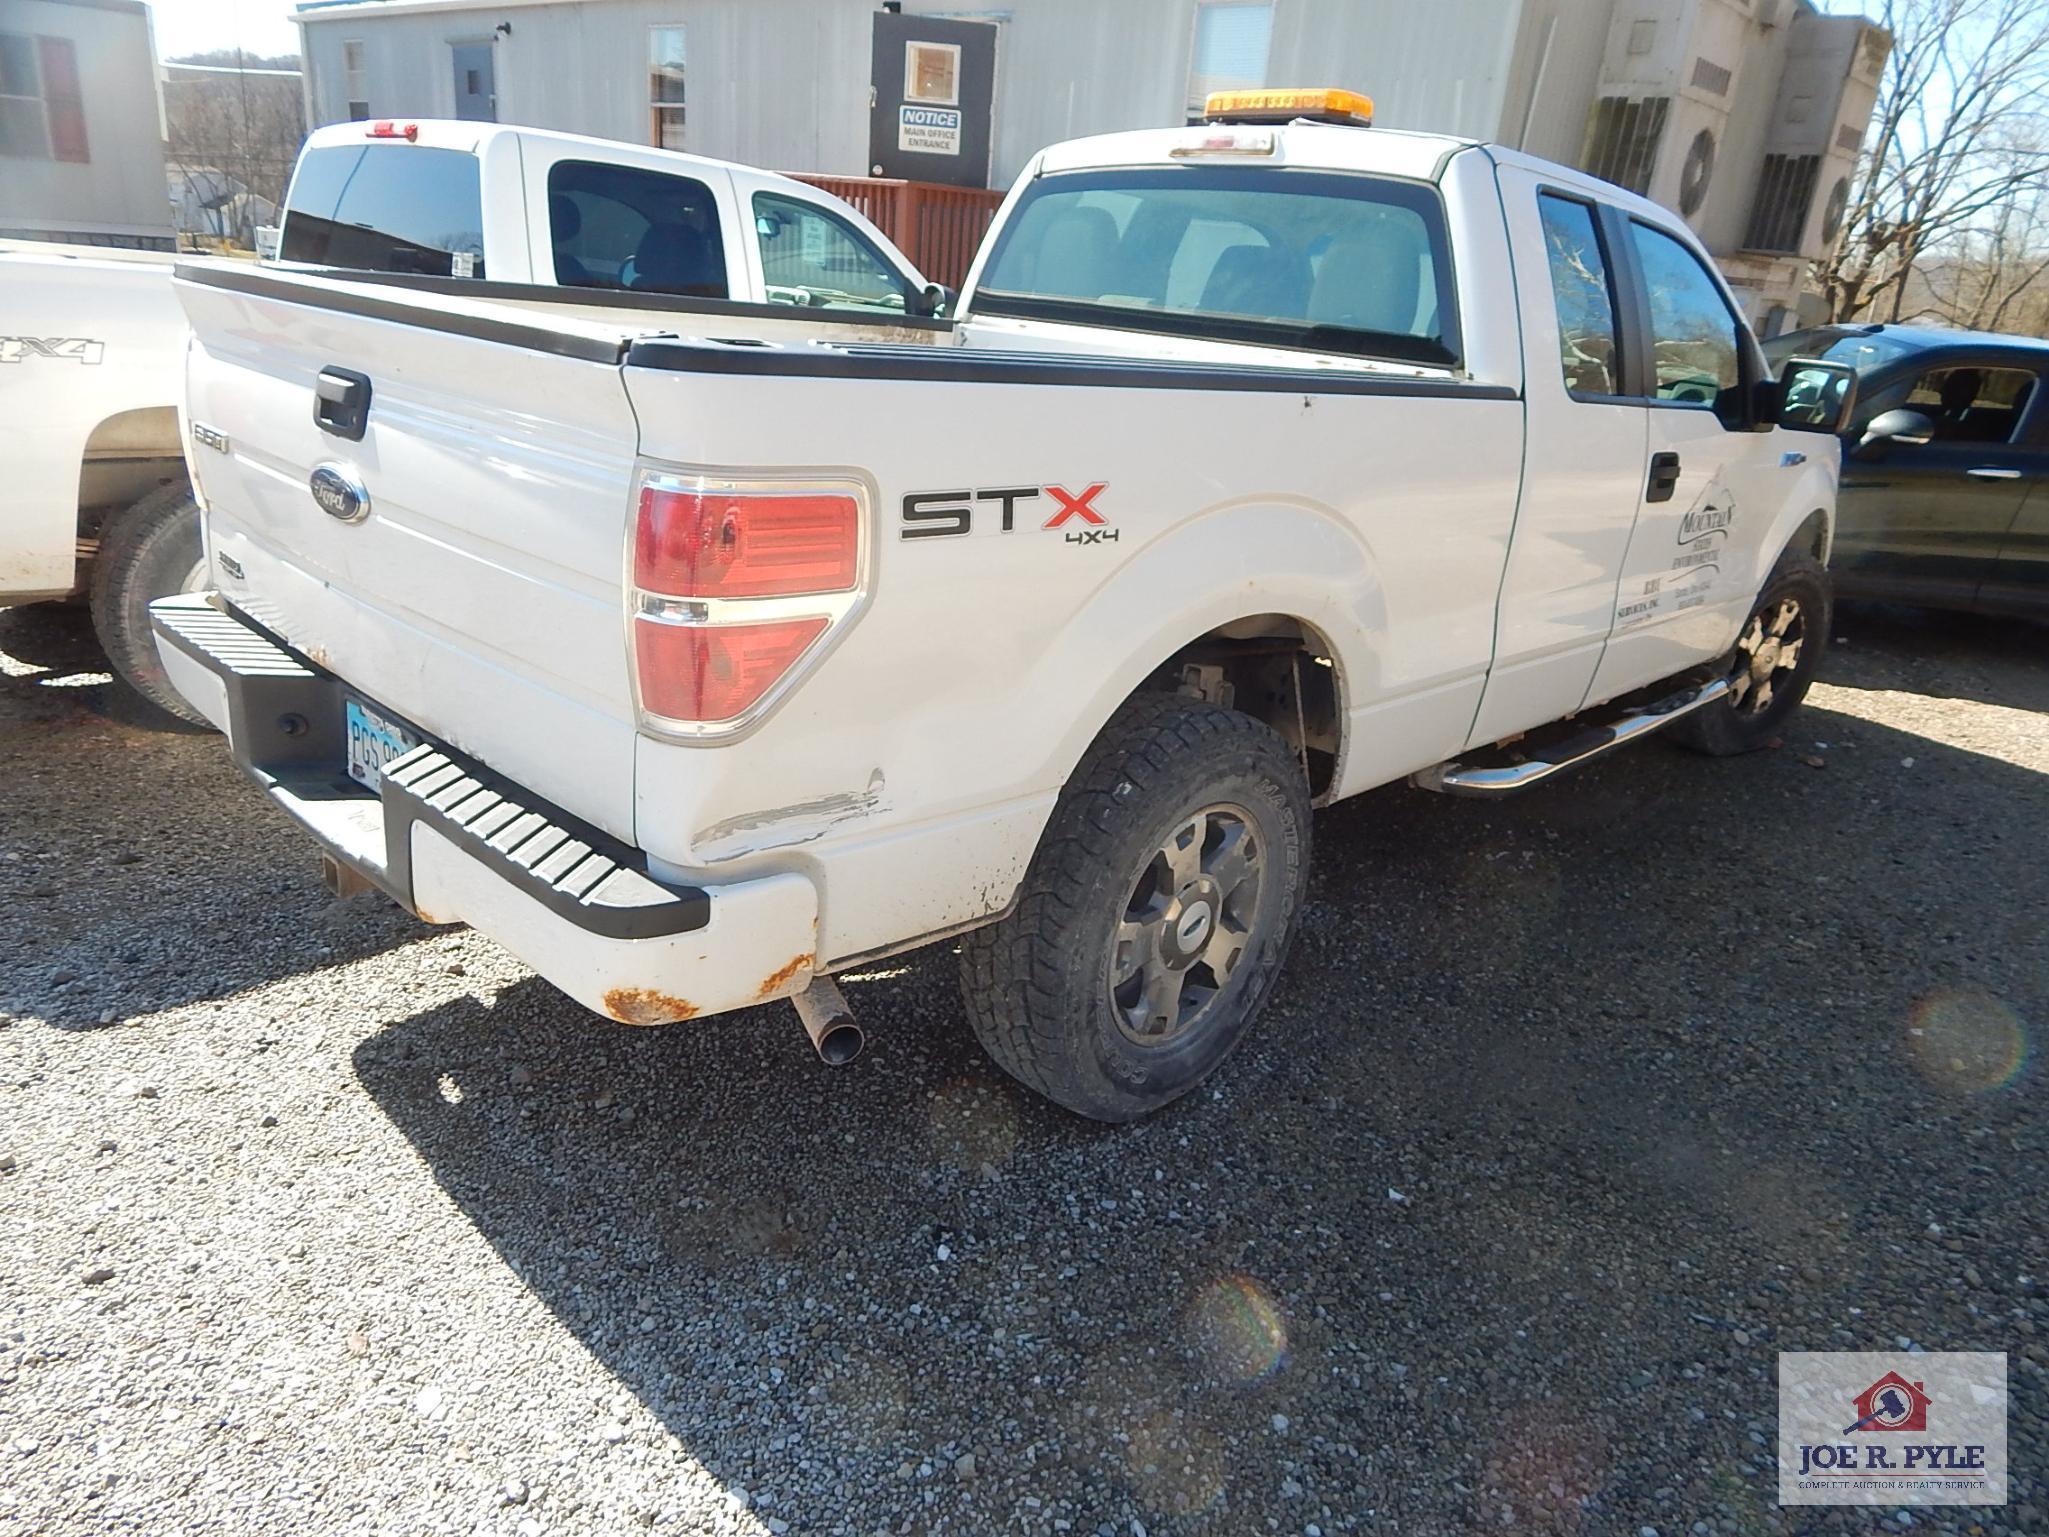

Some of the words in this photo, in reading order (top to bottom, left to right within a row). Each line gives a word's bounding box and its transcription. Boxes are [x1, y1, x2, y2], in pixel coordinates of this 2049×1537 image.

[904, 110, 957, 127] NOTICE
[904, 127, 926, 137] MAIN
[927, 129, 956, 140] OFFICE
[908, 138, 951, 149] ENTRANCE
[901, 483, 1108, 541] STX
[1065, 529, 1119, 546] 4X4
